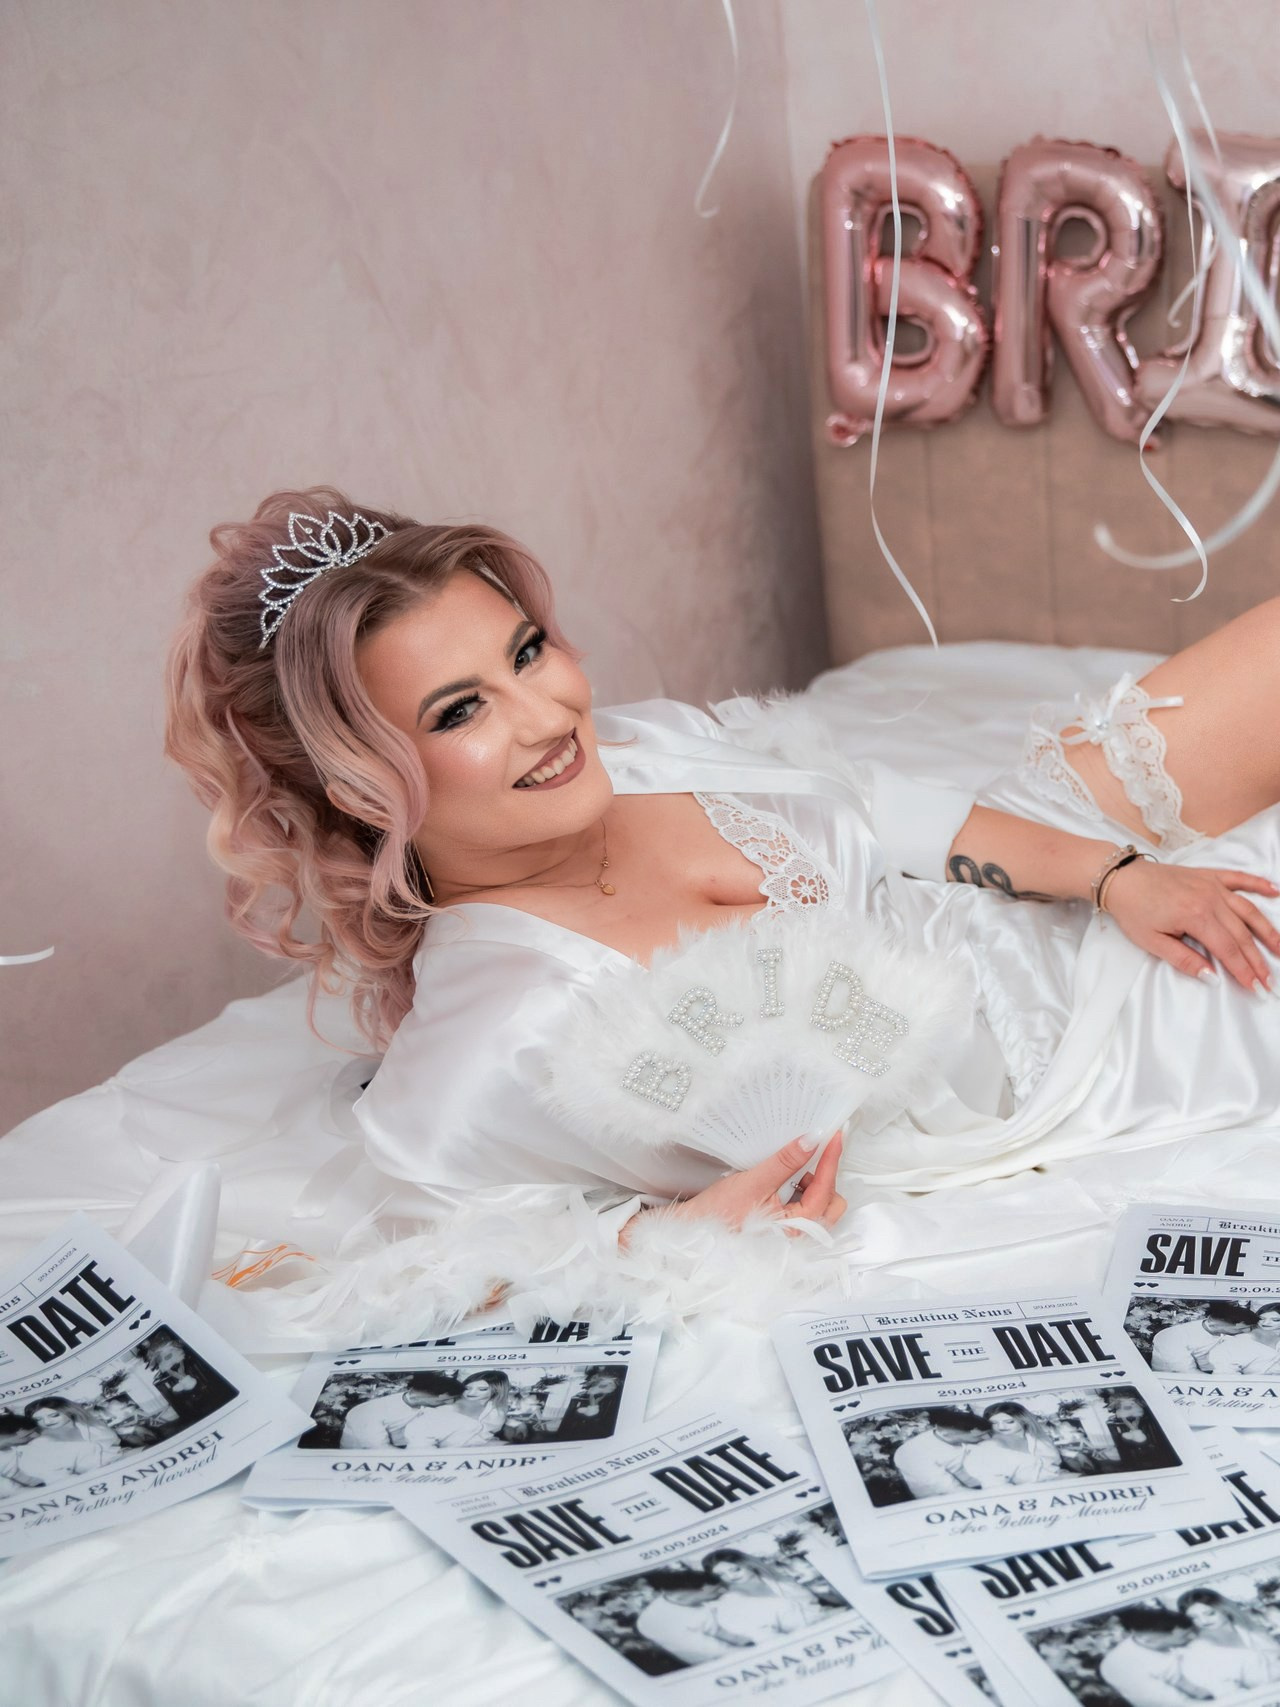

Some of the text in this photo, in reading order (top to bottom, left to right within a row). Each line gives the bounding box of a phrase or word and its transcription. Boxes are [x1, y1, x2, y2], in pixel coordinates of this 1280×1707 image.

[621, 948, 909, 1112] BRIDE
[1140, 1233, 1251, 1277] SAVE
[7, 1260, 136, 1363] DATE
[875, 1306, 1013, 1326] Breaking News
[437, 1353, 528, 1363] 29.09.2024
[813, 1318, 1116, 1394] SAVE THE DATE
[937, 1380, 1028, 1398] 29.09.2024
[1163, 1384, 1225, 1397] ANA
[1232, 1386, 1254, 1397] &
[121, 1430, 224, 1486] ANDREI
[332, 1461, 415, 1472] OANA
[424, 1461, 447, 1471] &
[518, 1446, 661, 1498] Breaking News
[73, 1489, 136, 1514] Getting
[142, 1445, 218, 1492] Married
[471, 1435, 801, 1569] SAVE THE DATE
[925, 1485, 1156, 1525] OANA & ANDREI
[949, 1495, 1148, 1537] Are Getting Married
[638, 1523, 729, 1560] 29.09.2024
[1116, 1561, 1211, 1595] 29.09.2024
[715, 1654, 801, 1688] OANA
